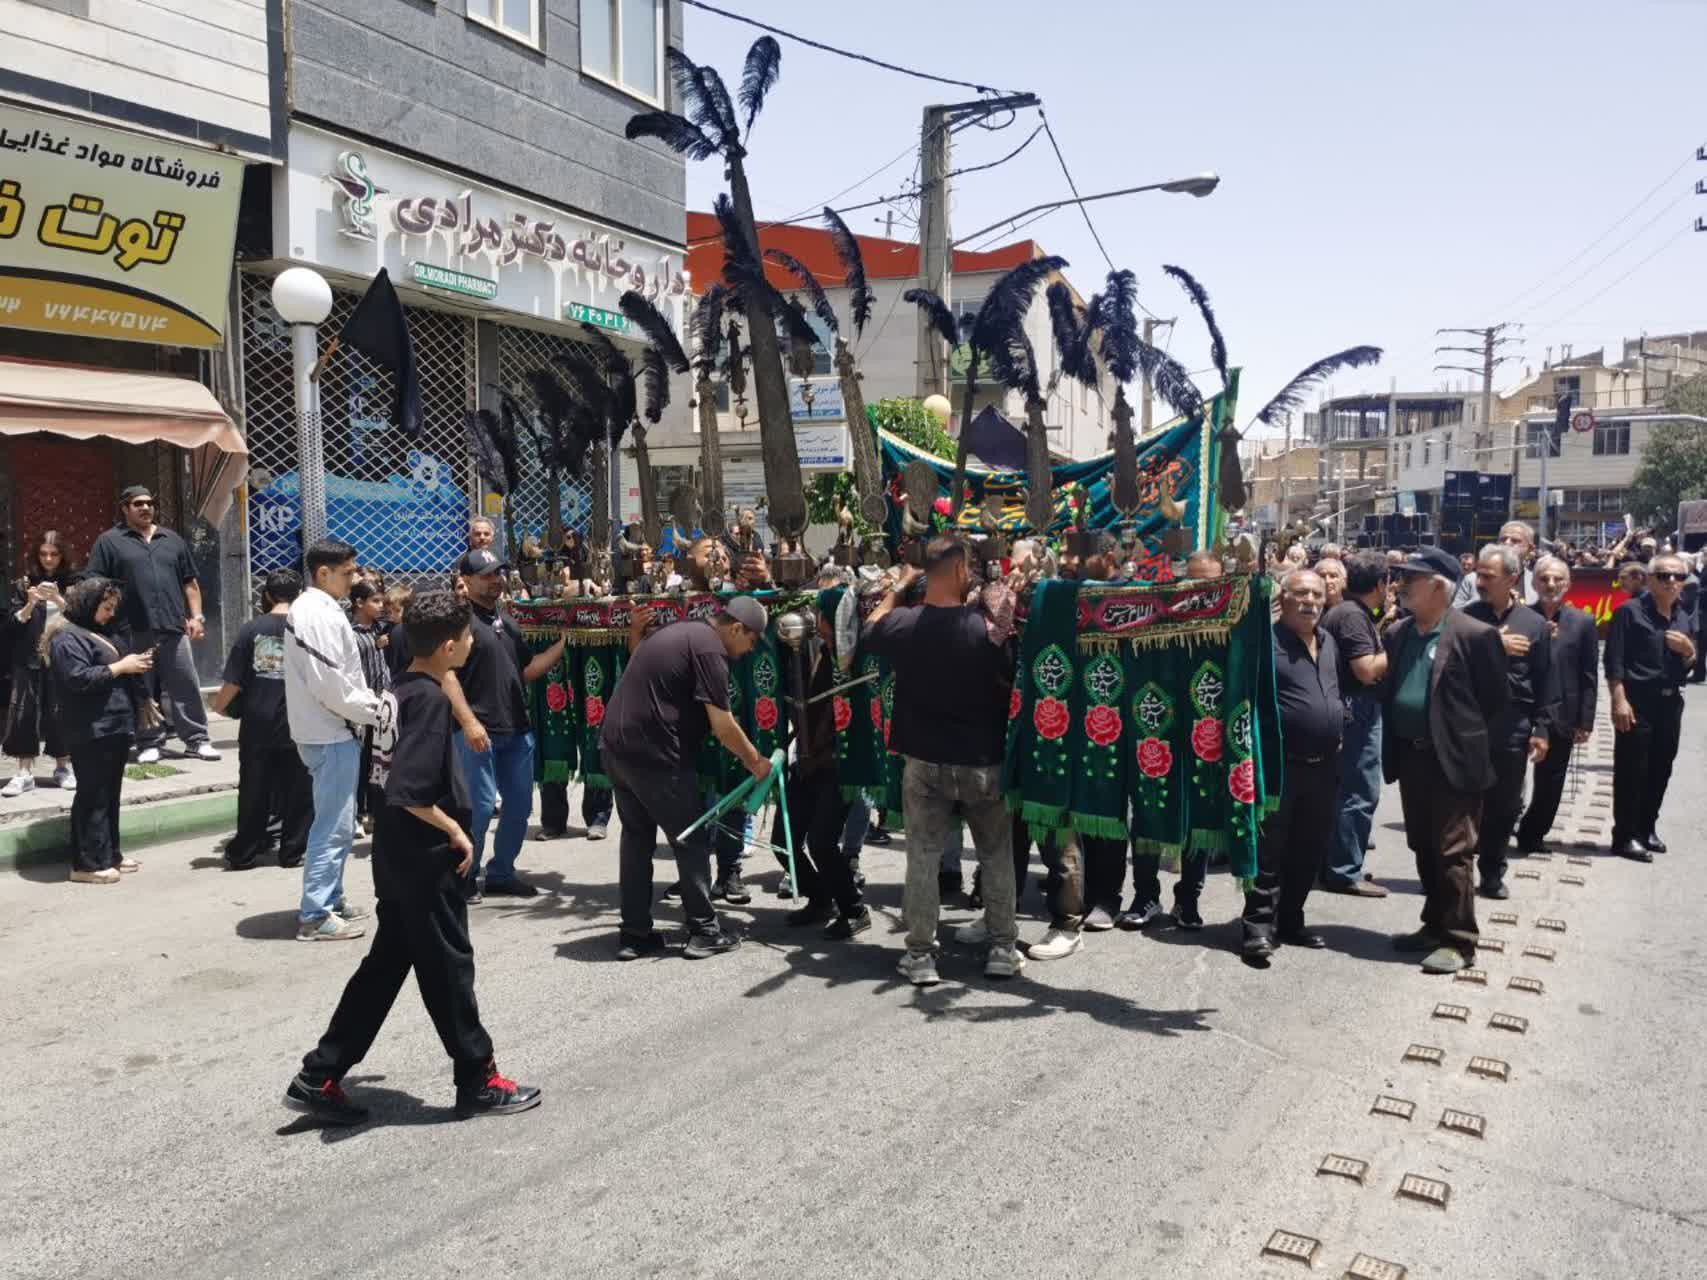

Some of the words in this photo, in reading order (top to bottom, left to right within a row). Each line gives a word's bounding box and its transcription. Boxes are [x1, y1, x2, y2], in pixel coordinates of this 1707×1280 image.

[75, 144, 124, 168] مواد
[131, 156, 220, 188] فروشگاه
[37, 193, 186, 271] توت
[395, 190, 502, 257] مرادی
[499, 213, 567, 266] دکتر
[571, 231, 687, 298] داروخانه
[258, 501, 295, 532] KP
